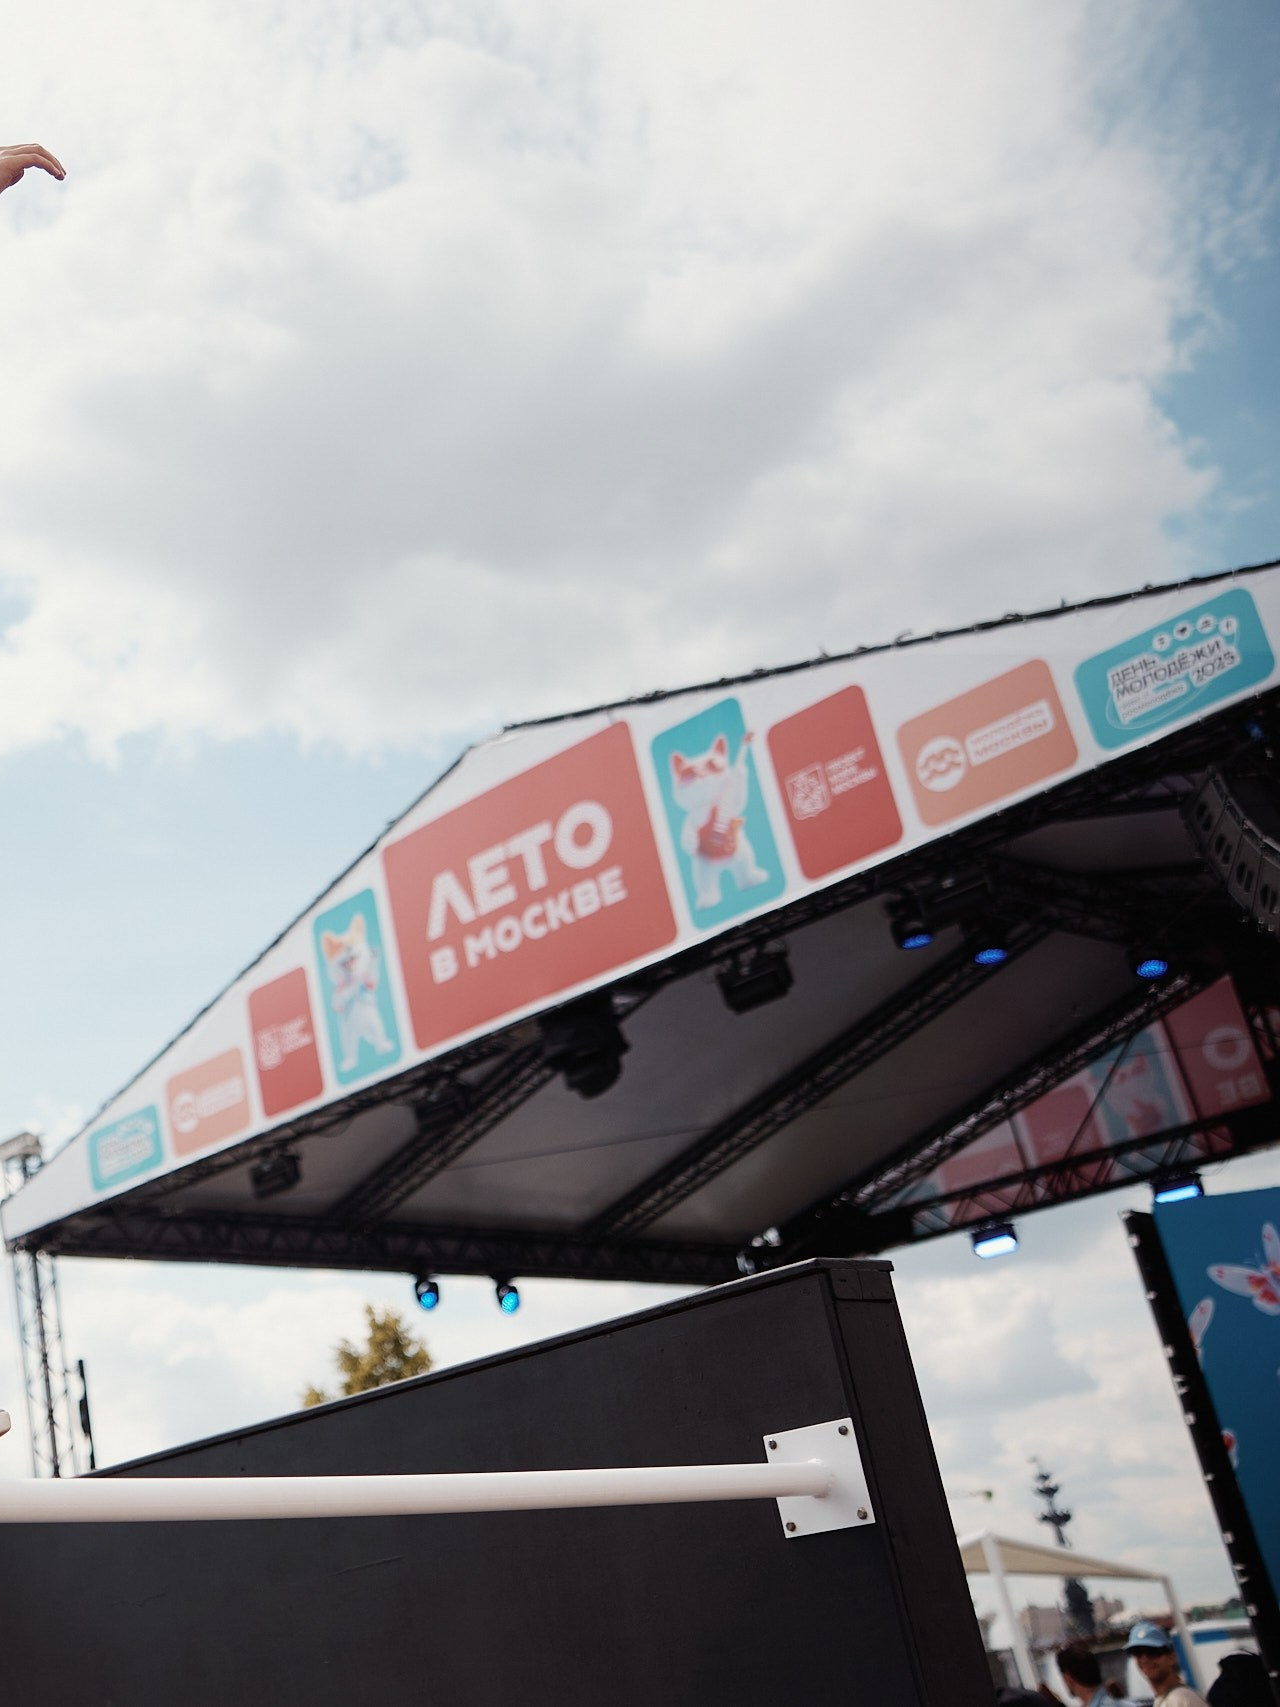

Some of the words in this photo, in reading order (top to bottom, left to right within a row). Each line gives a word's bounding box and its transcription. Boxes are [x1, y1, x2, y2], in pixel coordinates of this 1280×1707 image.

[1111, 657, 1156, 687] ДЕНЬ
[1116, 640, 1221, 698] МОЛОДЁЖИ
[1194, 652, 1235, 681] 2025
[427, 801, 613, 941] ЛЕТО
[430, 946, 459, 984] В
[463, 866, 627, 967] МОСКВЕ
